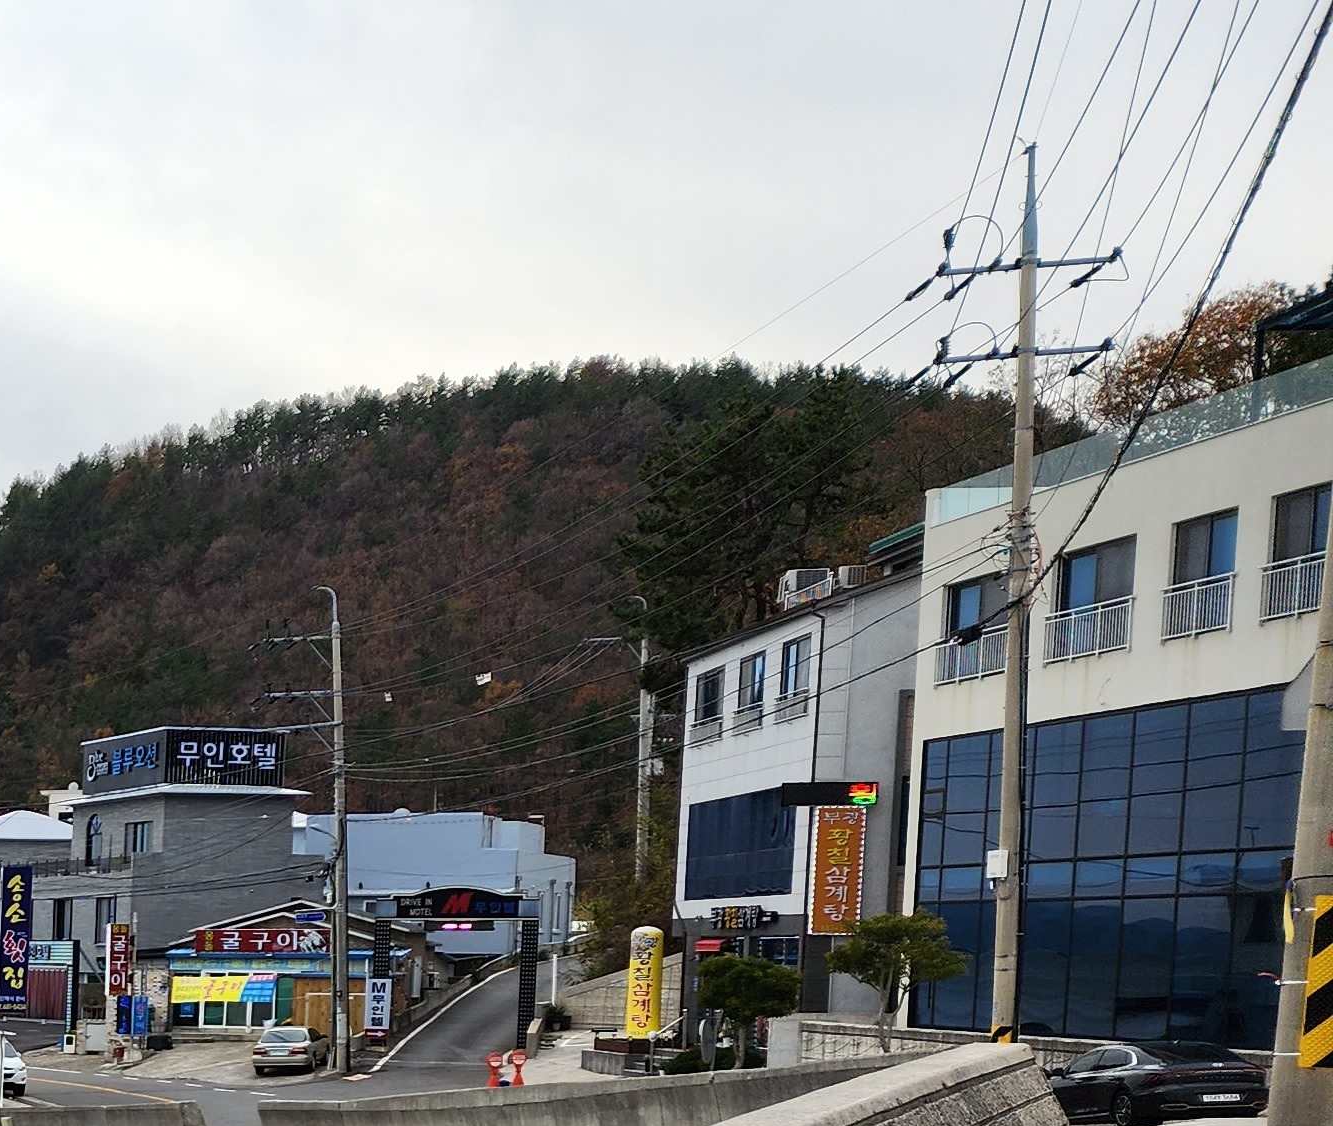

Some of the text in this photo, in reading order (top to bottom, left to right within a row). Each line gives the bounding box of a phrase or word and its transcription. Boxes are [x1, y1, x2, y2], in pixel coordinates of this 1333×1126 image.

[112, 742, 157, 775] 블루오션
[177, 741, 277, 770] 무인호텔
[823, 811, 859, 825] 부광
[823, 827, 854, 922] 황칠삼계탕
[400, 898, 433, 906] DRIVE IN
[409, 908, 433, 916] MOTEL
[440, 892, 474, 914] M
[2, 874, 28, 990] 송소횟집
[220, 931, 298, 951] 굴구이
[111, 934, 128, 989] 굴구이
[632, 951, 655, 1029] 황칠삼계탕
